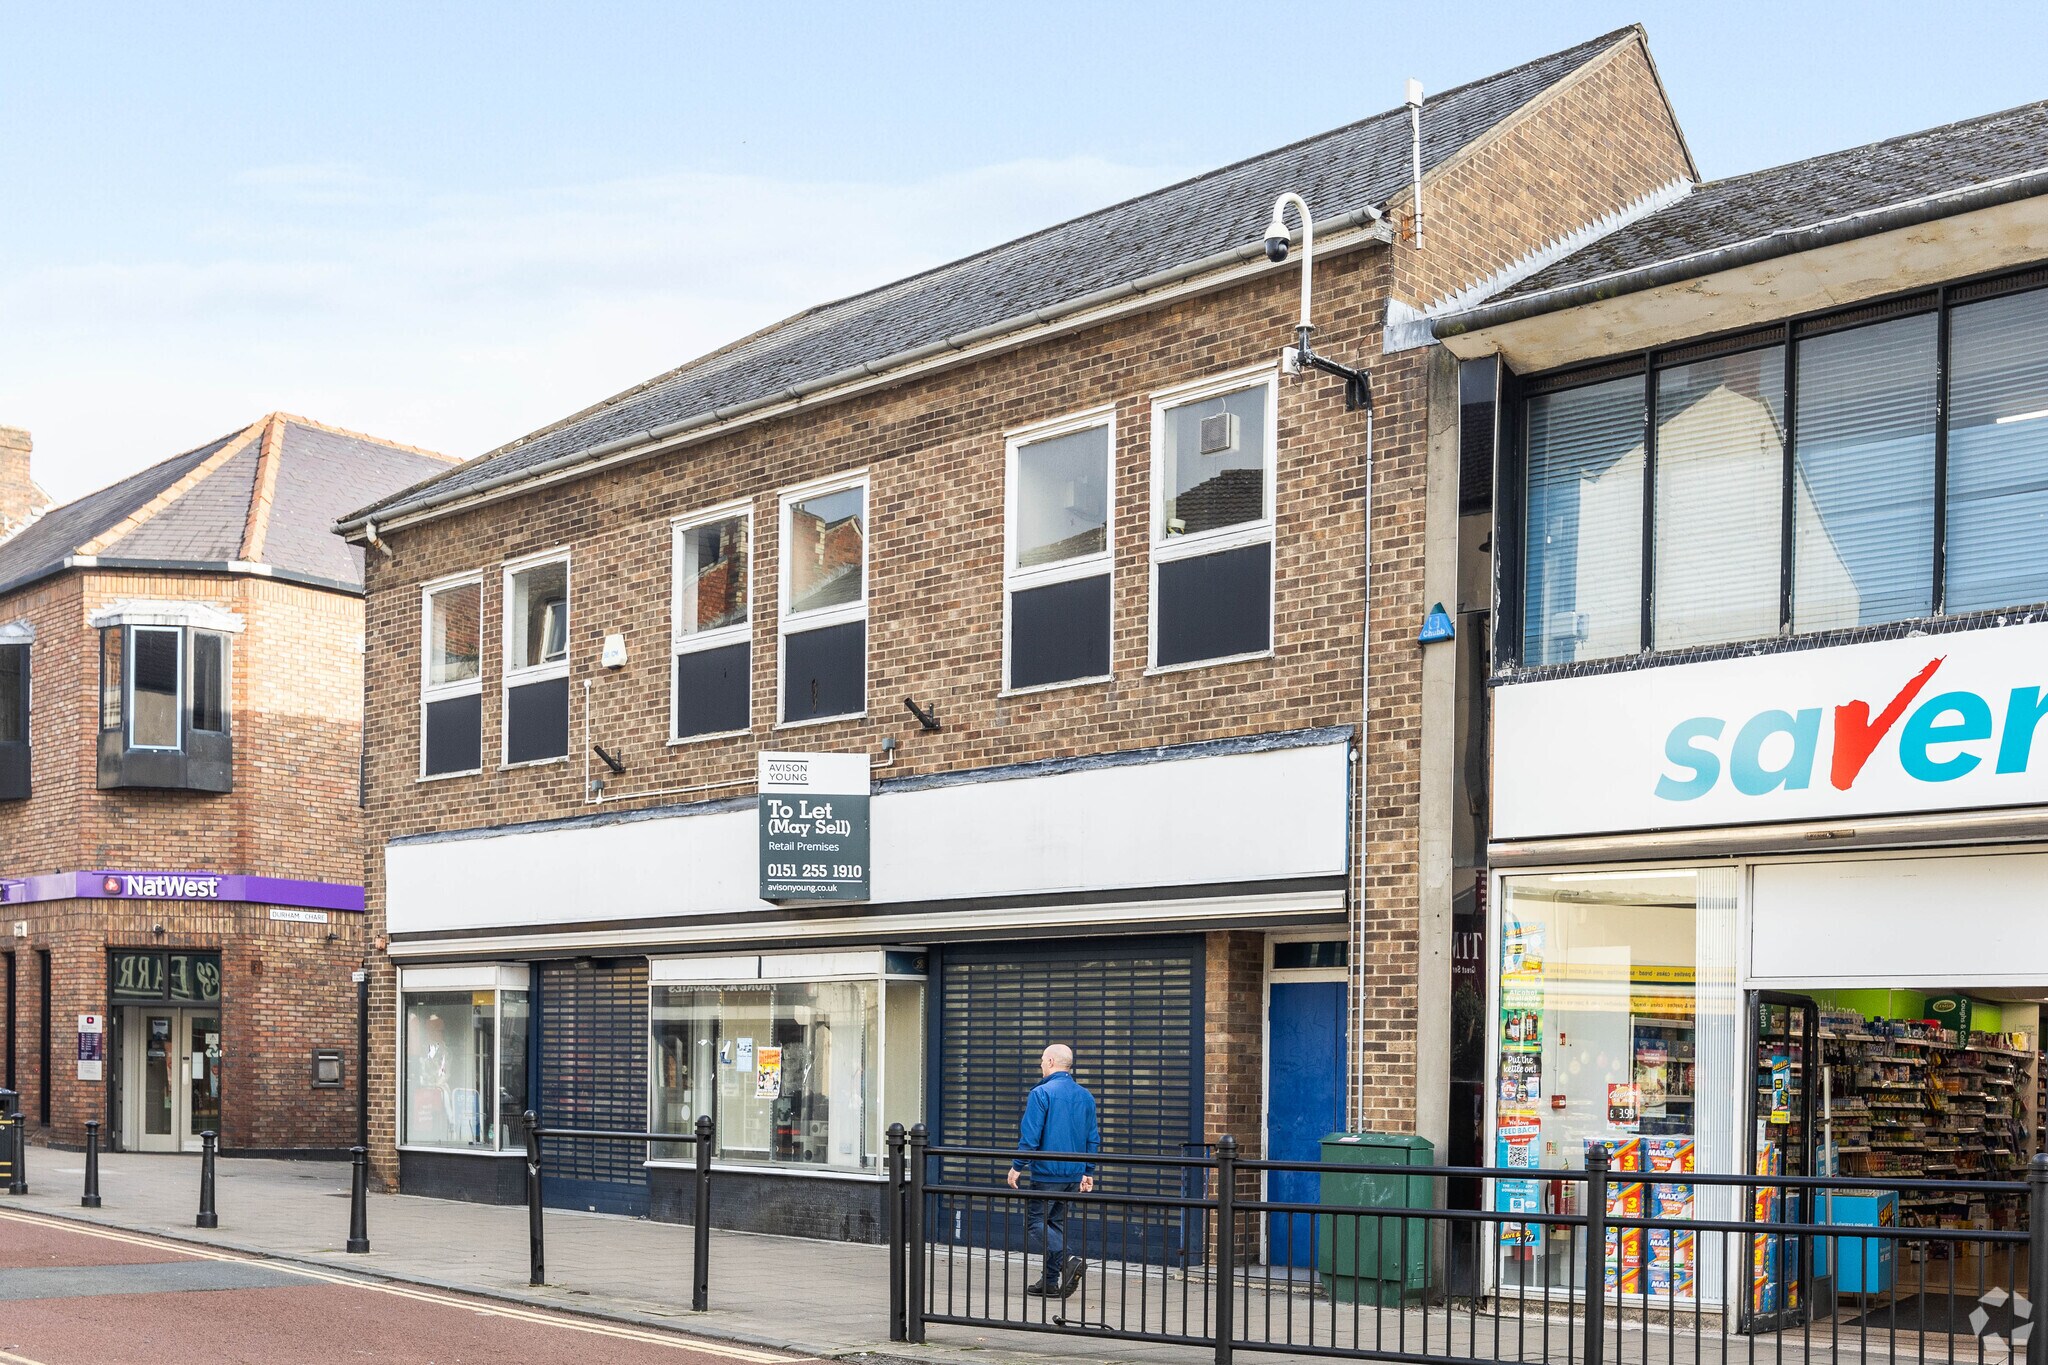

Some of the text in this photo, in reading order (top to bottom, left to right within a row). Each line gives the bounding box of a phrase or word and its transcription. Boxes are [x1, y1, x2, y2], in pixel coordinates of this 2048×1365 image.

[769, 764, 808, 772] AVISON
[769, 773, 807, 782] YOUNG
[767, 799, 833, 819] To Let
[768, 818, 851, 837] (May Sell)
[768, 841, 840, 852] Retail Premises
[767, 863, 862, 878] 0151 255 1910
[127, 875, 218, 897] NatWest
[767, 883, 838, 893] avisonyoung.co.uk
[272, 911, 326, 921] DURHAM CHARE
[1507, 1055, 1534, 1064] Put the
[1503, 1064, 1537, 1073] kettle on!
[1500, 1126, 1538, 1135] FEEDBACK
[1623, 1155, 1635, 1167] 3
[1626, 1197, 1638, 1209] 3
[1627, 1240, 1638, 1252] 3
